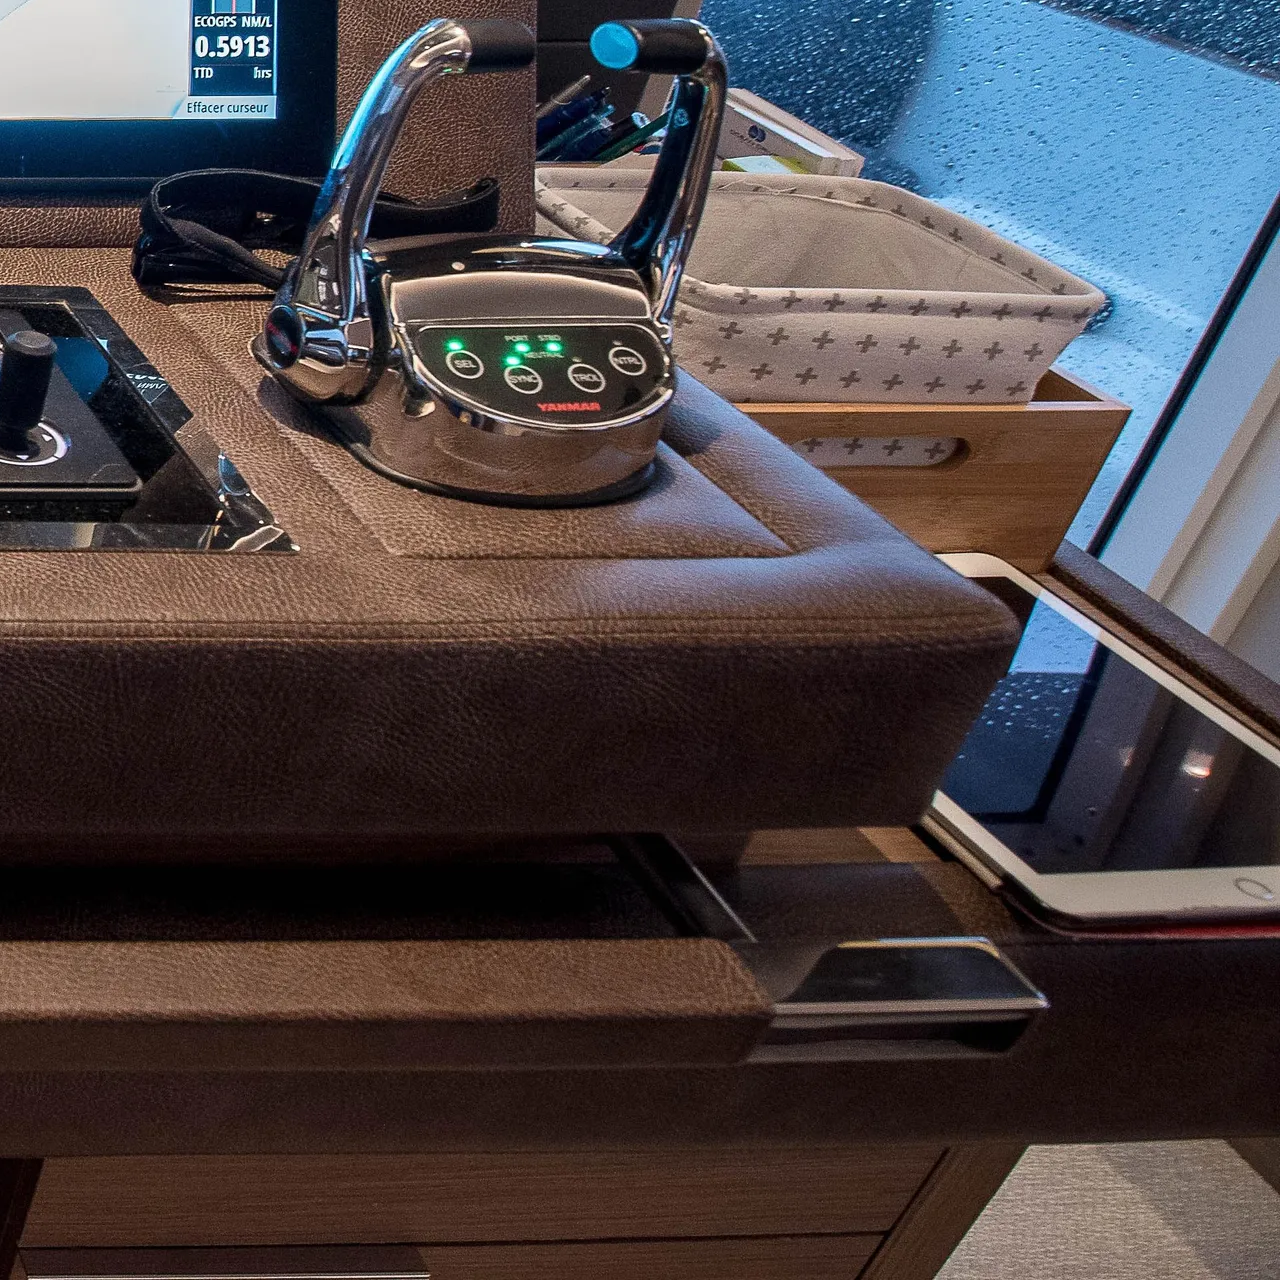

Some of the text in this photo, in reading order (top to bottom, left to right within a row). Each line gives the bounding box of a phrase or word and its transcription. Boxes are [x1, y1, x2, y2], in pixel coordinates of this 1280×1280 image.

[194, 15, 272, 27] ECOGPS NM/L
[195, 35, 271, 58] 0.5913
[193, 66, 272, 79] TTD hrs
[187, 101, 268, 113] Effacer curseur
[454, 359, 477, 369] SEL
[537, 402, 601, 412] YANMAR
